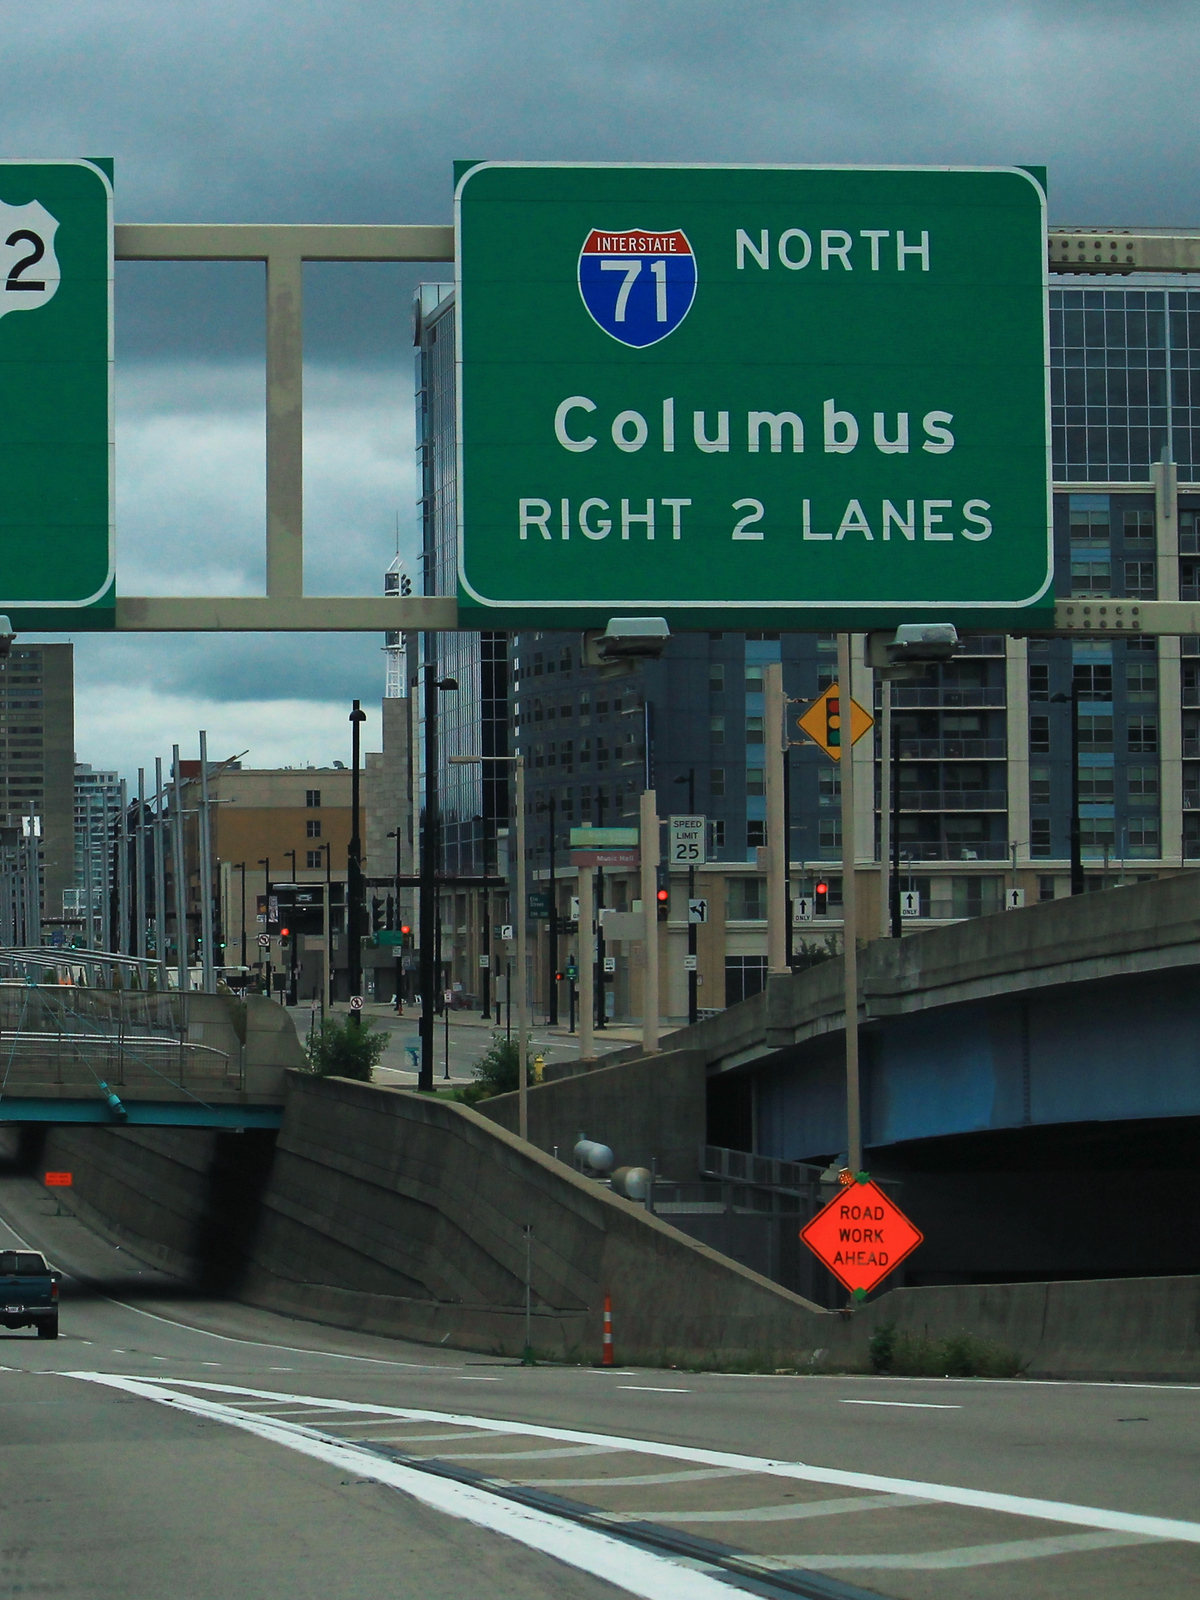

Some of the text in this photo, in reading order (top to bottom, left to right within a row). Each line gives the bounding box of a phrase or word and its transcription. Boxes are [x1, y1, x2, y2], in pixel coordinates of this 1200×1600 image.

[596, 237, 677, 253] INTERSTATE
[736, 229, 930, 272] NORTH
[600, 259, 668, 322] 71
[555, 396, 955, 454] Columbus
[519, 498, 993, 541] RIGHT 2 LANES
[673, 820, 702, 828] SPEED
[676, 832, 699, 840] LIMIT
[676, 843, 699, 860] 25
[840, 1205, 885, 1221] ROAD
[839, 1228, 884, 1243] WORK
[833, 1251, 889, 1267] AHEAD
